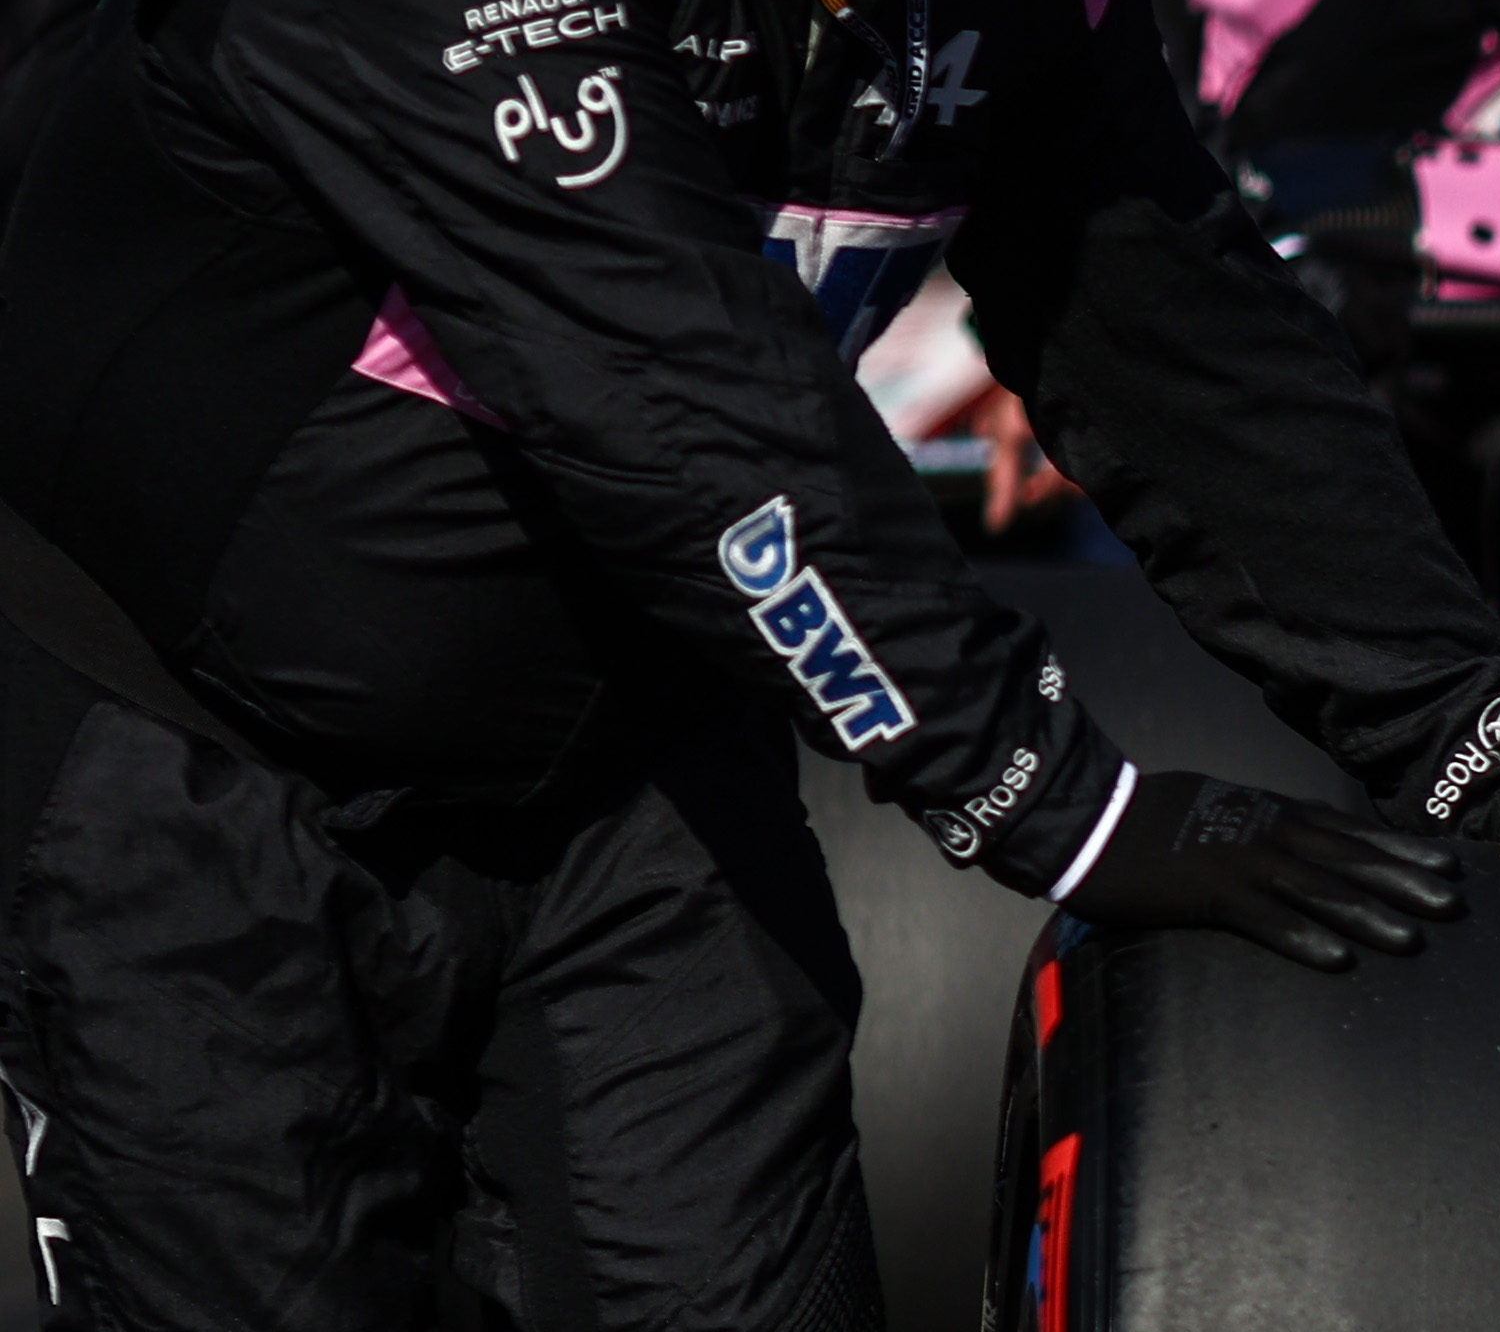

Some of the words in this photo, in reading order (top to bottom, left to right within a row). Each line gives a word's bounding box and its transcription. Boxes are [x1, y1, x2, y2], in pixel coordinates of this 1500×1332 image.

[442, 2, 630, 75] E-TECH
[493, 72, 631, 191] plug
[747, 565, 919, 753] BWT
[964, 746, 1040, 829] Ross
[1426, 741, 1491, 821] Ross
